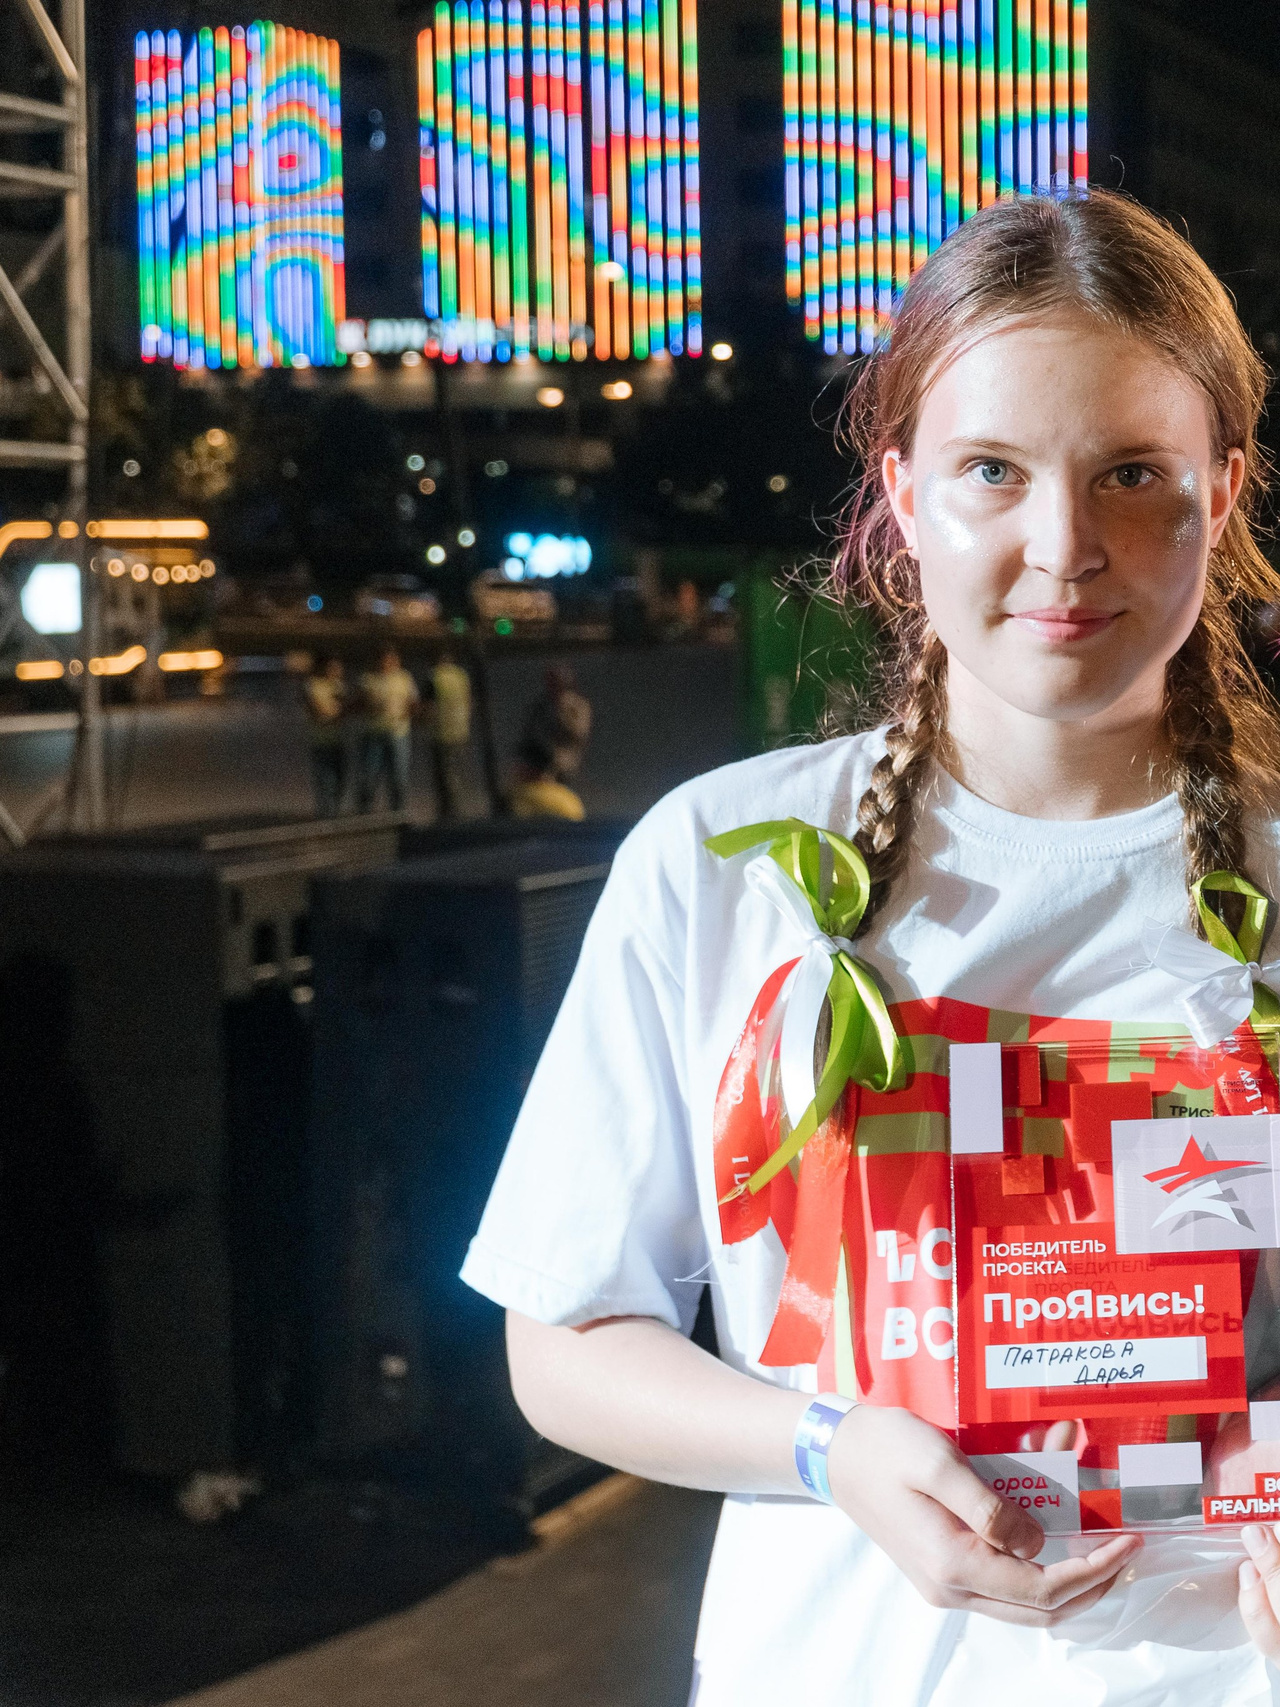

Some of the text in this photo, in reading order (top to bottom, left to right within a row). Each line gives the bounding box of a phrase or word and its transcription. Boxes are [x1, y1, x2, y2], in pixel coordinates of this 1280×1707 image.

[1169, 1105, 1215, 1118] ТРИС
[982, 1239, 1107, 1258] ПОБЕДИТЕЛЬ
[983, 1260, 1068, 1277] ПРОЕКТА
[983, 1284, 1206, 1329] ПроЯвись!
[1003, 1341, 1134, 1367] ПАТРАКОВА
[993, 1476, 1048, 1495] ород
